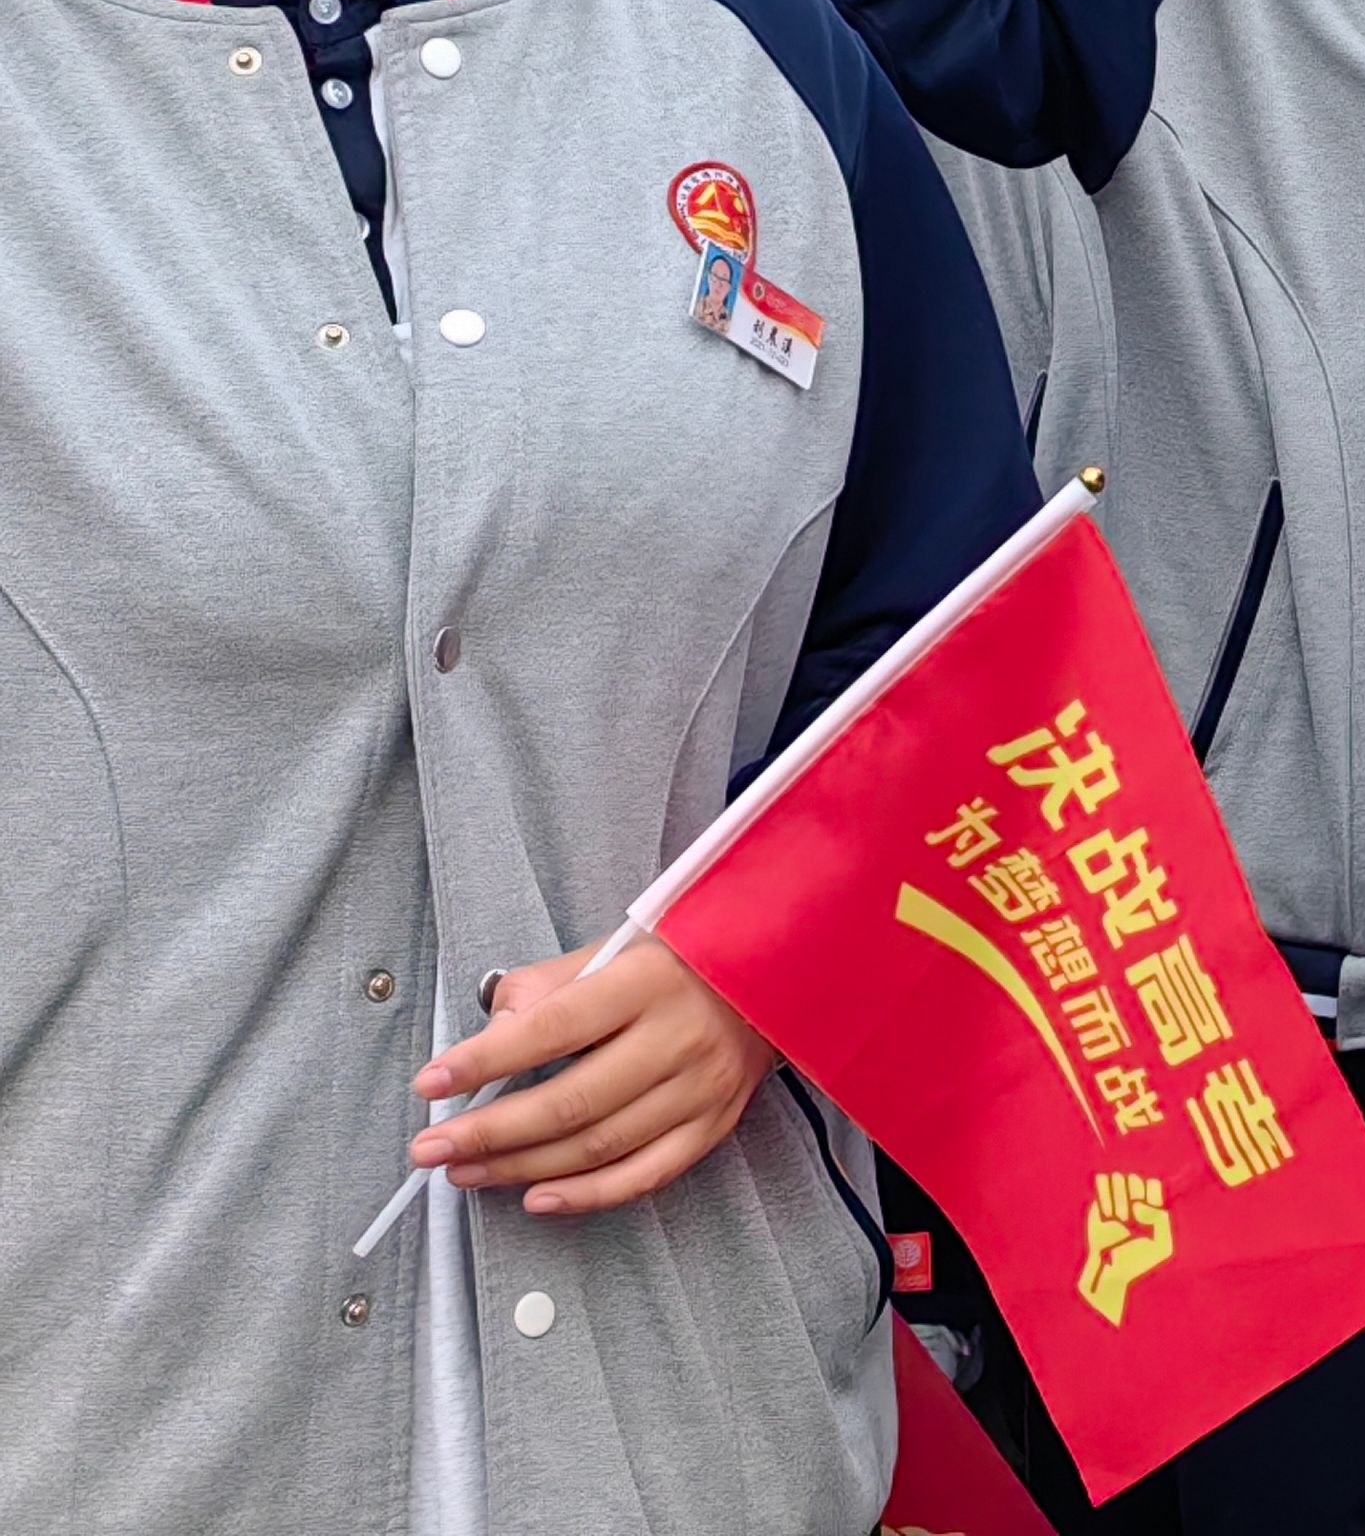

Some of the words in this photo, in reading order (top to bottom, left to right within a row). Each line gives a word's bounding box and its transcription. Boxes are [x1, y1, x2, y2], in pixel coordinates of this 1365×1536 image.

[923, 795, 1165, 1137] 为梦想而战
[987, 698, 1298, 1189] 决战高考
